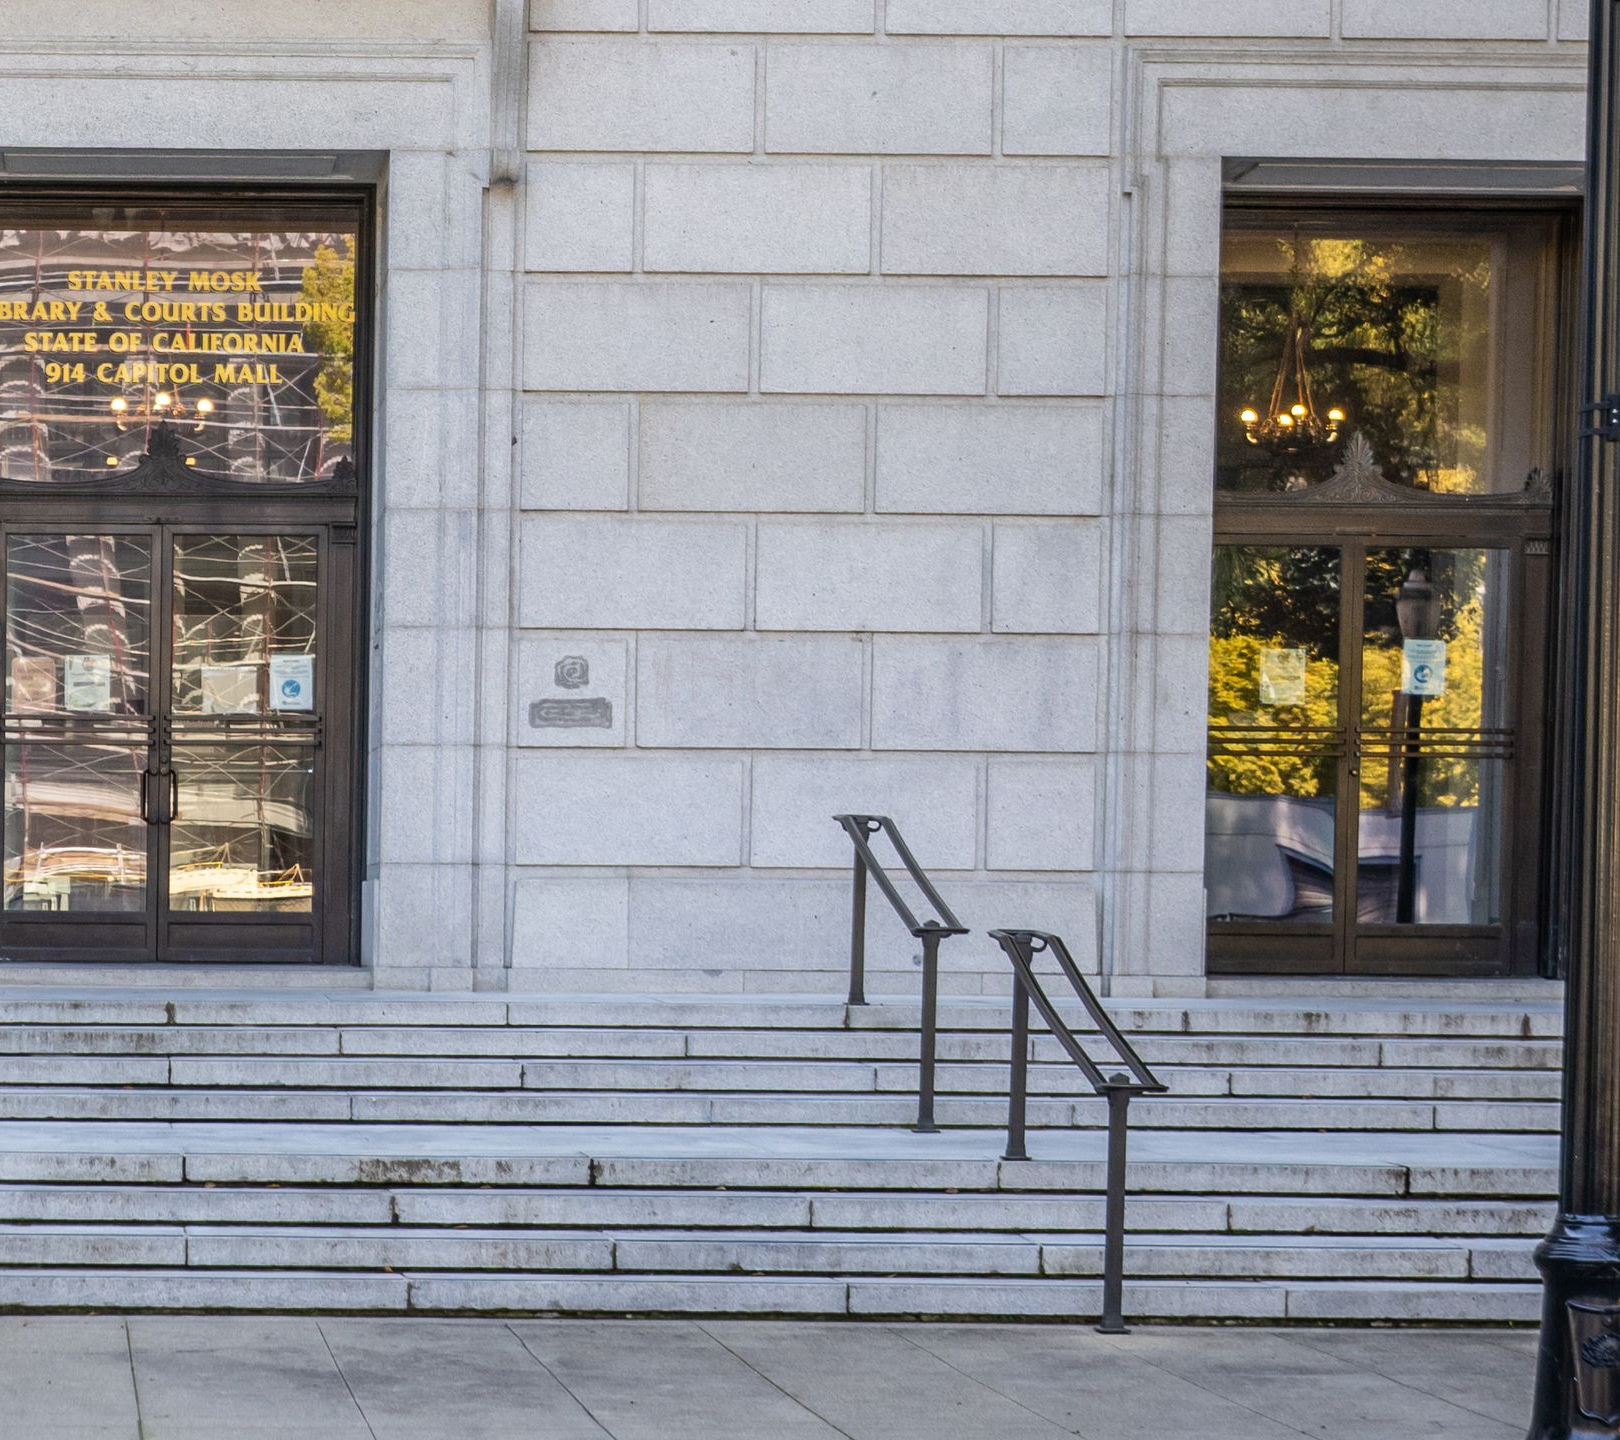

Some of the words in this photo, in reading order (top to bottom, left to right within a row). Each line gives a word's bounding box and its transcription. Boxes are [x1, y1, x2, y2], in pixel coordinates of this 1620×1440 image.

[68, 270, 178, 292] STANLEY
[188, 271, 263, 293] MOSK
[93, 302, 113, 322] &
[124, 301, 227, 322] COURTS
[237, 302, 356, 323] BUILDING
[24, 332, 97, 353] STATE
[109, 332, 143, 353] OF
[152, 332, 305, 354] CALIFORNIA
[45, 363, 85, 384] 914
[97, 363, 203, 384] CAPITOL
[214, 363, 283, 385] MALL
